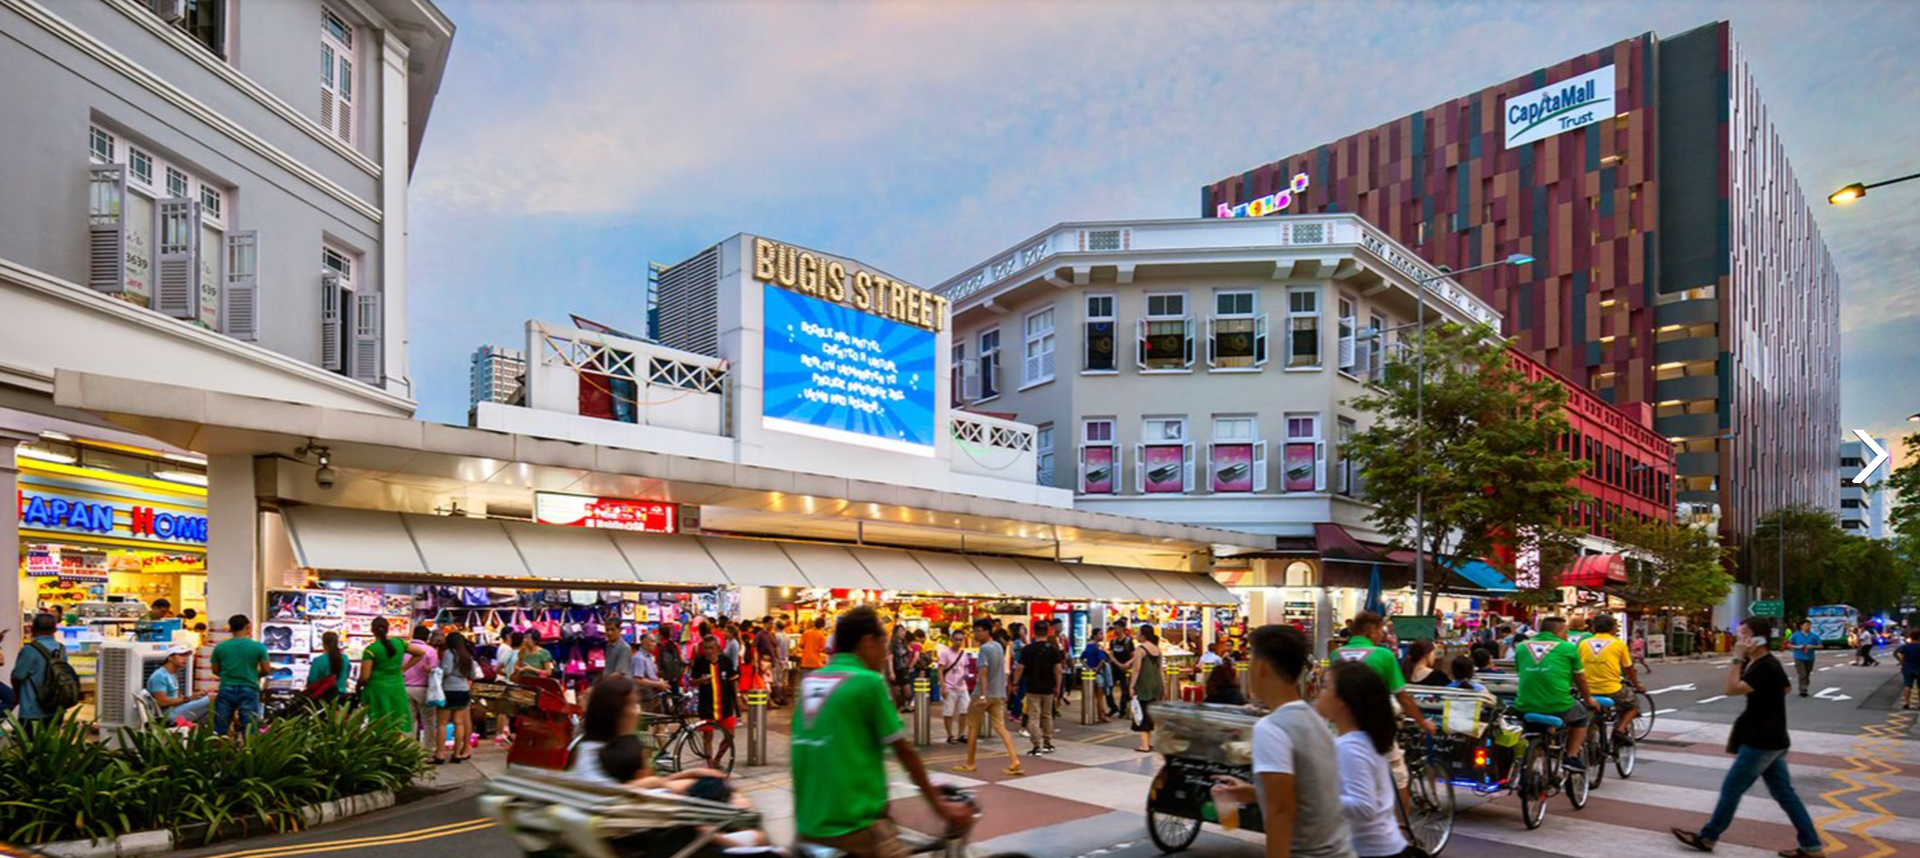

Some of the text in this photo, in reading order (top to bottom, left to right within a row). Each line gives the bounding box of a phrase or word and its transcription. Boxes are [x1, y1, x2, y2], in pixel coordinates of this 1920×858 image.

[1509, 79, 1595, 125] CapitaMall
[1558, 111, 1594, 129] Trust
[754, 237, 947, 332] BUGIS STREET
